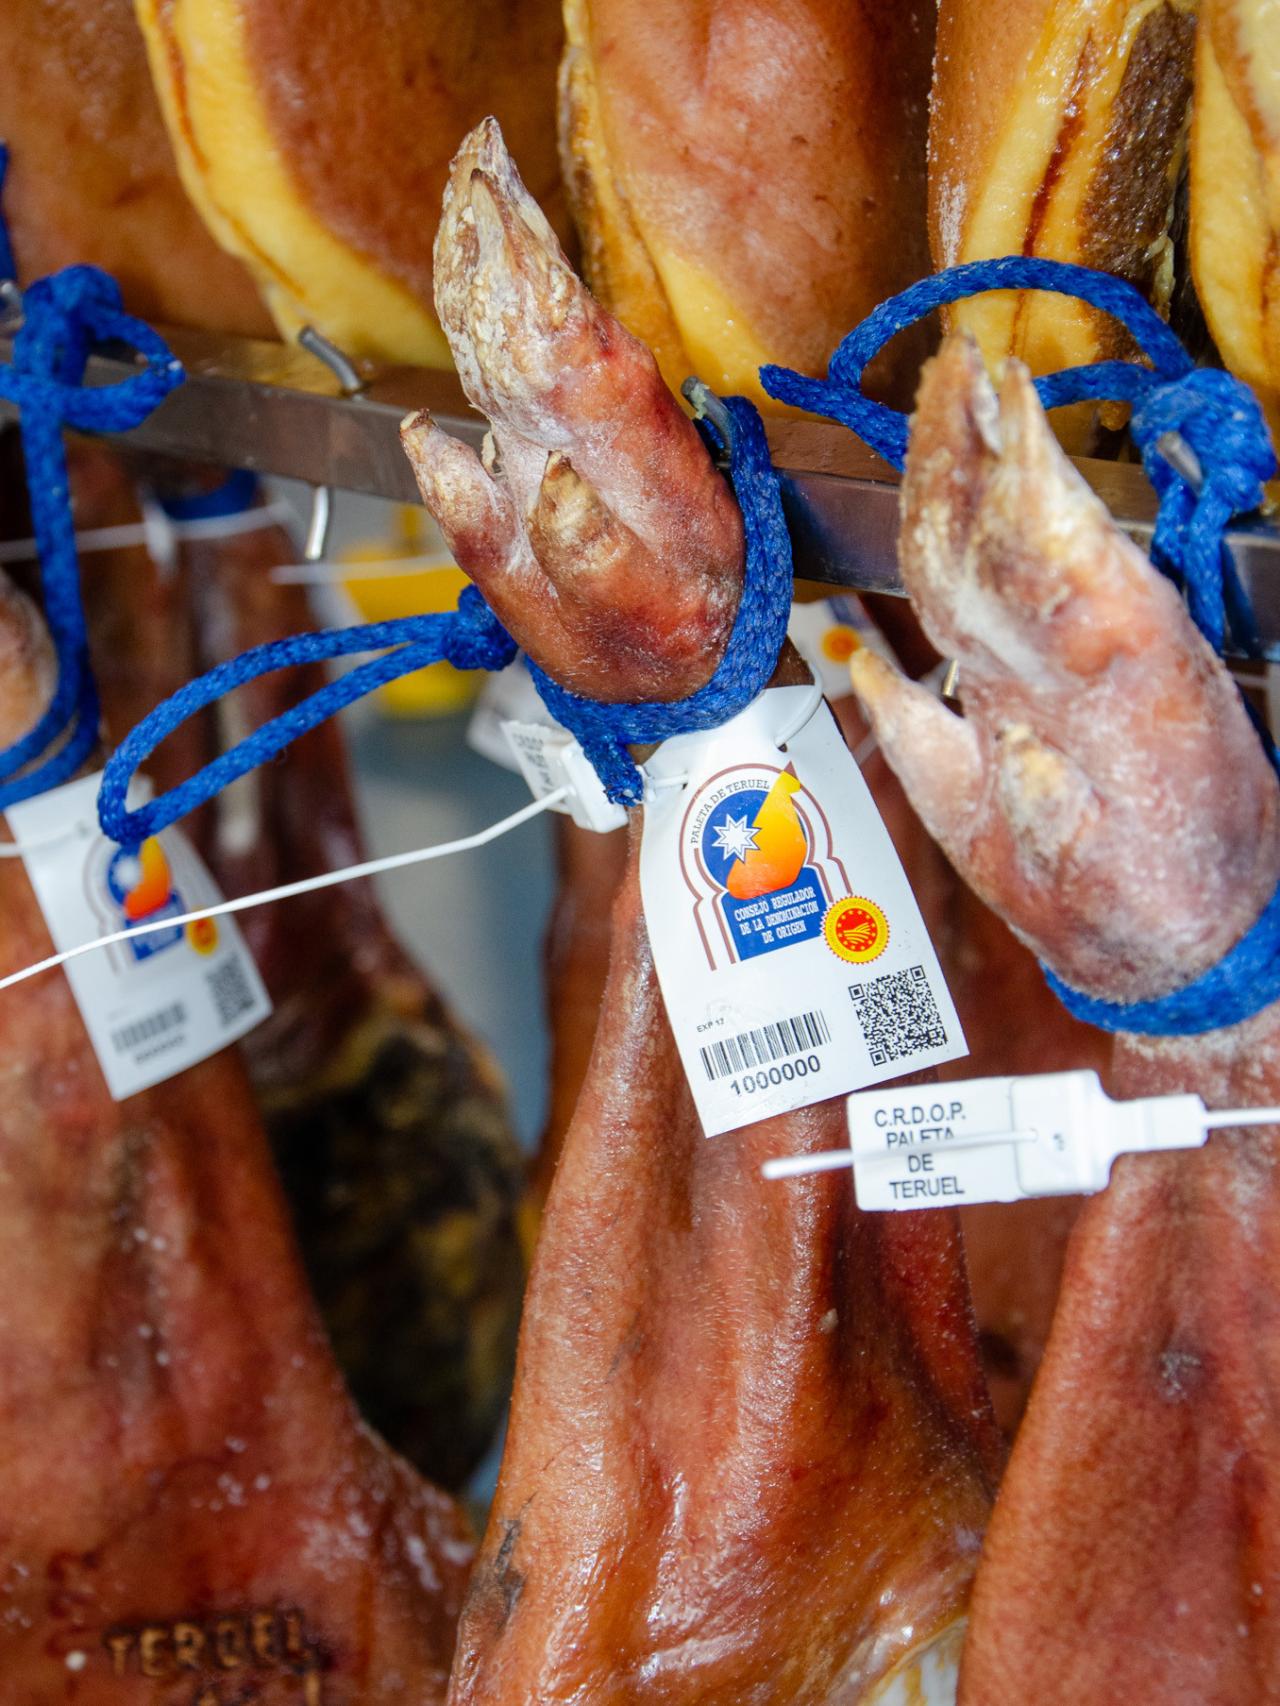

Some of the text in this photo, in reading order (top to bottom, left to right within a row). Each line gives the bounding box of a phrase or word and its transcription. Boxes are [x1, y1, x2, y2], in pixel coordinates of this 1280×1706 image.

[690, 779, 770, 844] PALETA DE TERUEL
[734, 886, 817, 921] CONSEJO REGULADOR
[739, 923, 751, 935] DE
[752, 918, 764, 931] LA
[761, 919, 807, 944] DE ORIGEN
[696, 1021, 713, 1033] EXP
[730, 1054, 821, 1096] 1000000
[874, 1101, 966, 1127] C.R.D.O.P.
[907, 1152, 934, 1173] DE
[889, 1176, 965, 1199] TERUEL
